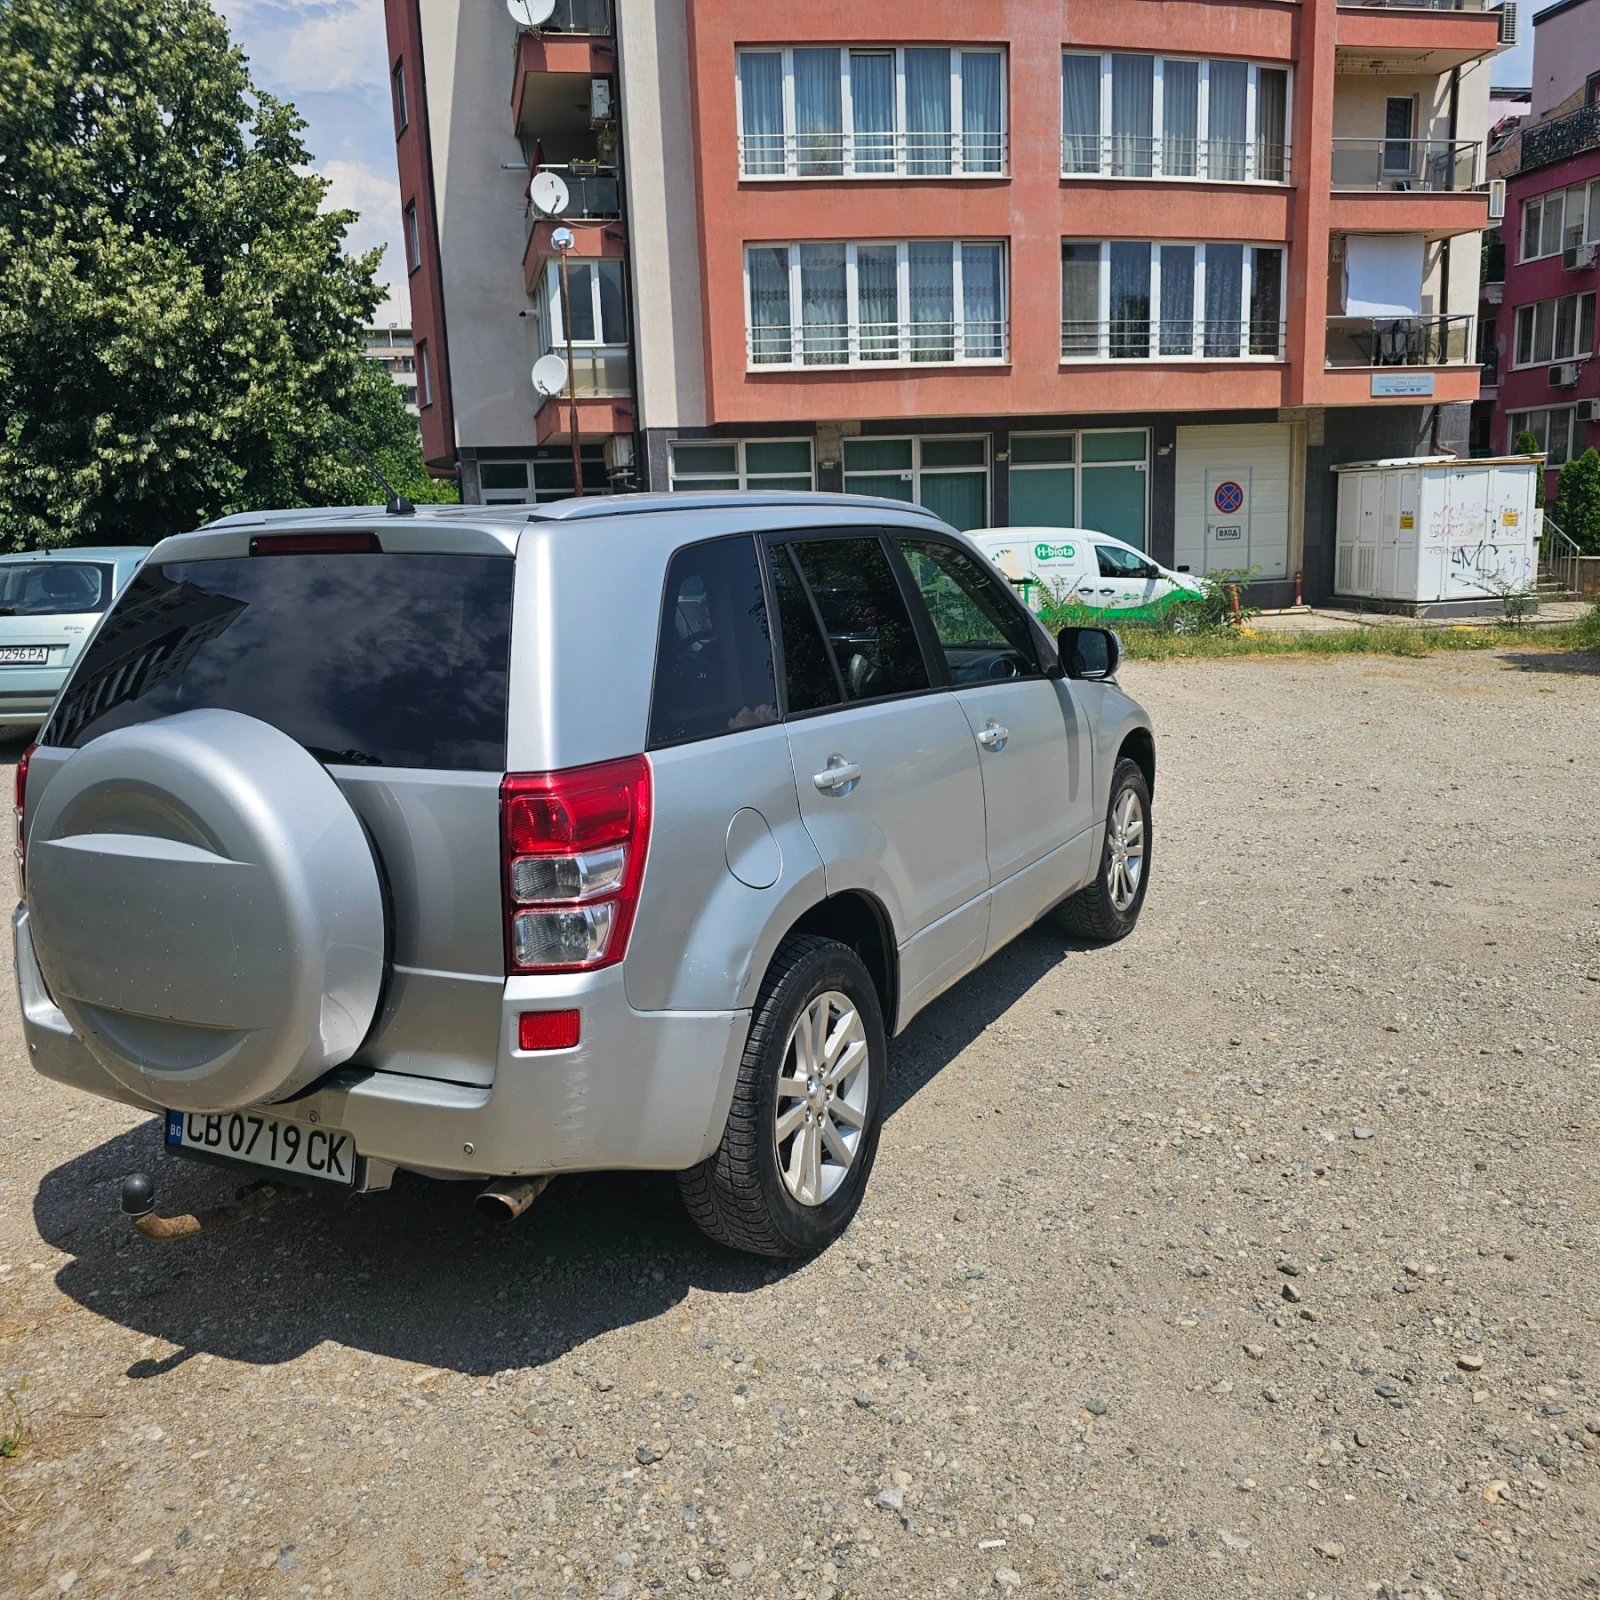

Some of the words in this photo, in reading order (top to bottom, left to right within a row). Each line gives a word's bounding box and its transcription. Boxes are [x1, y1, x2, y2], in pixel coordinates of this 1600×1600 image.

[1219, 529, 1238, 537] ВХОД
[28, 648, 44, 660] PA
[170, 1123, 182, 1137] BG
[228, 1113, 301, 1165] 0719
[306, 1129, 348, 1177] CK
